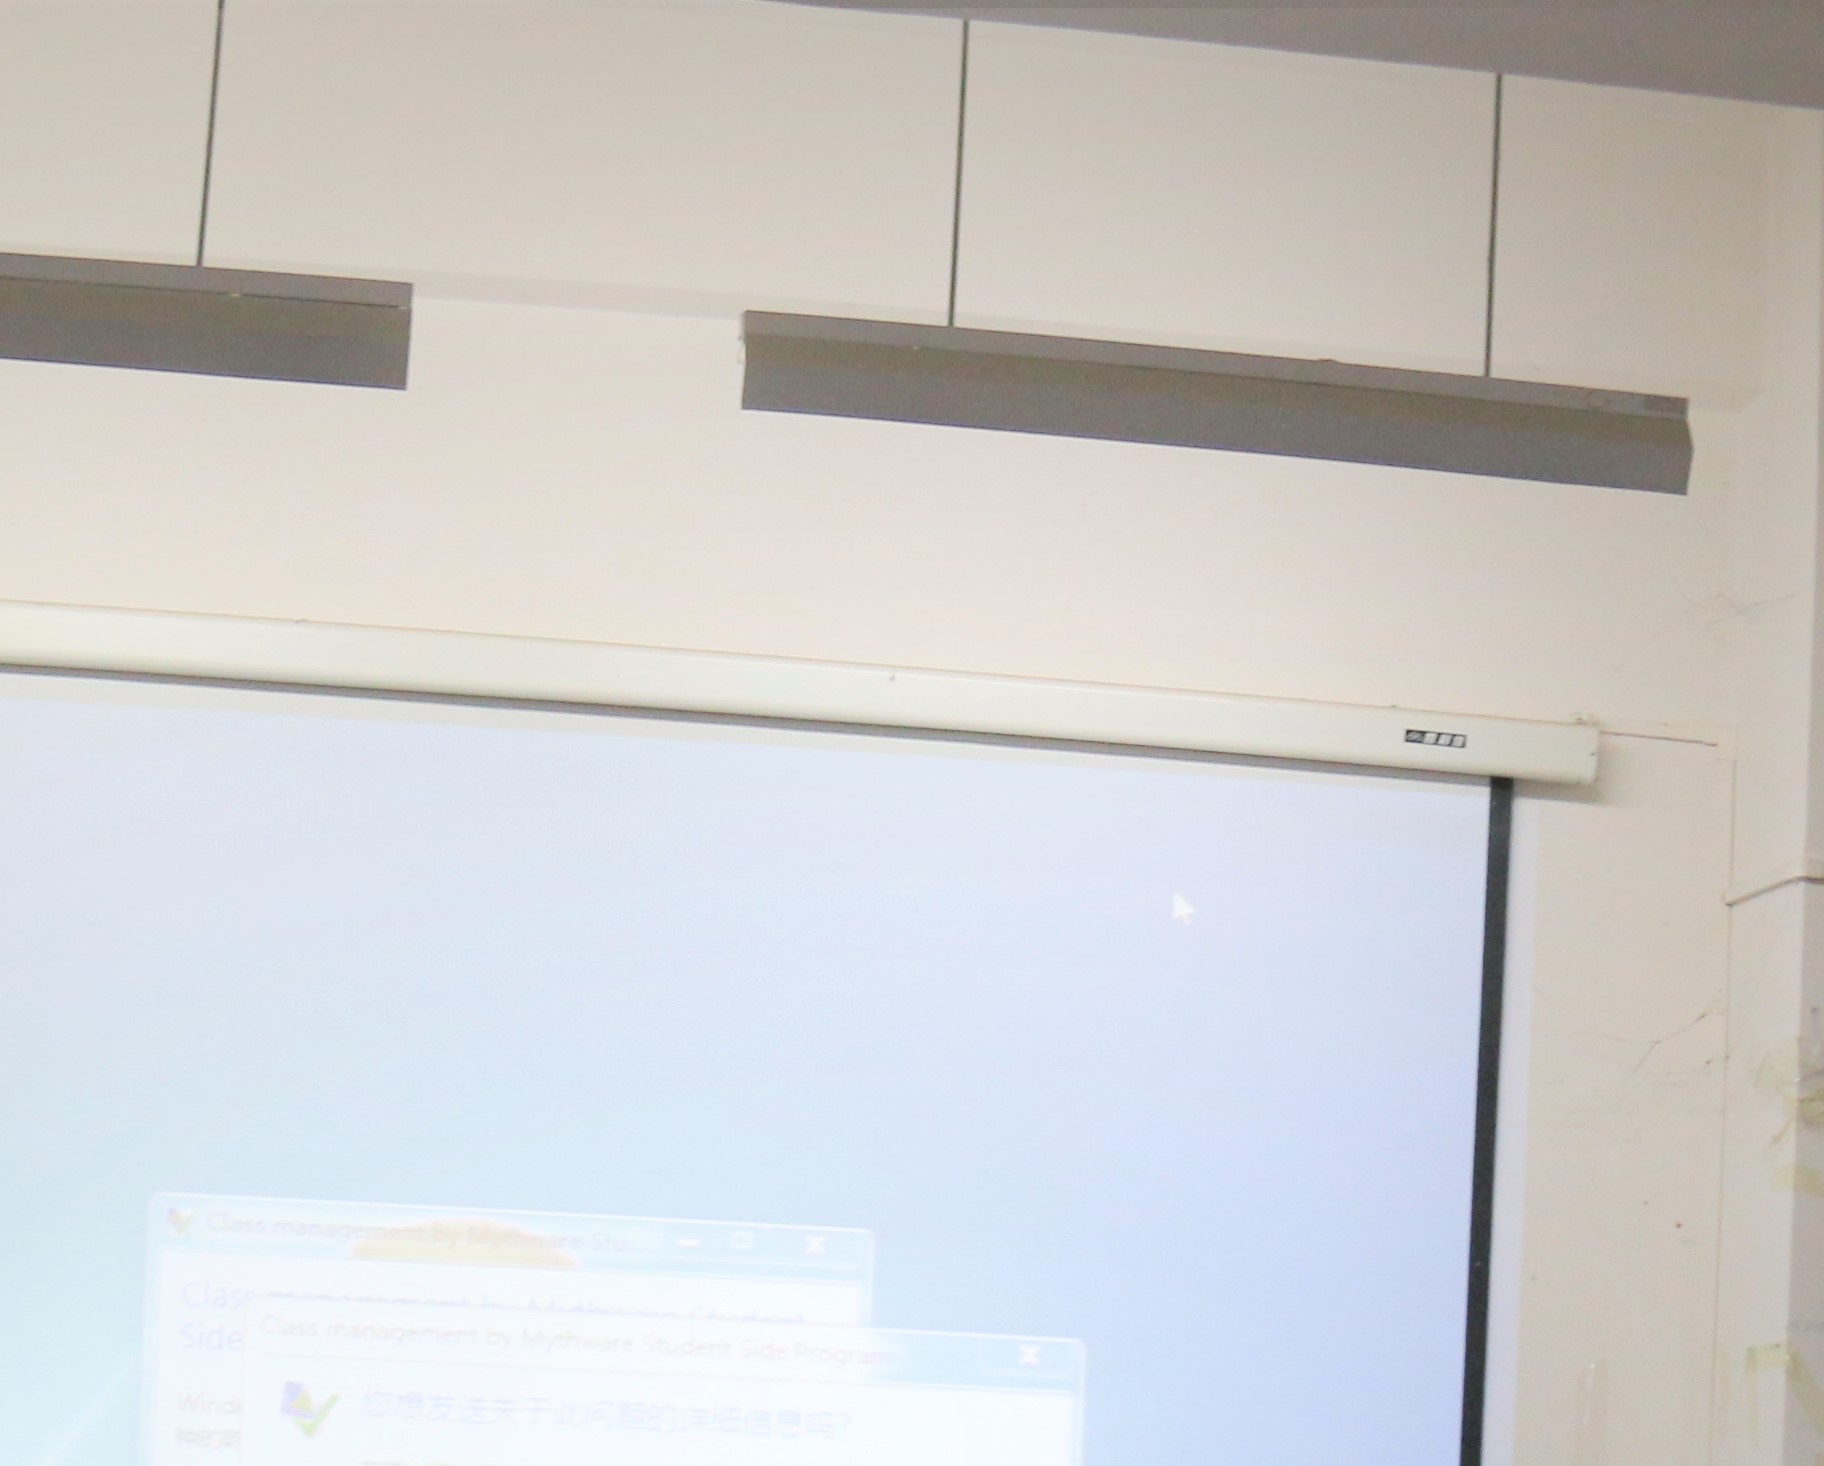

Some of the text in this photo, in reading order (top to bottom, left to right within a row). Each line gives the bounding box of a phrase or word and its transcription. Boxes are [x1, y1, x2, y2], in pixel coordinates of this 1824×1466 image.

[260, 1313, 319, 1339] Class
[327, 1321, 480, 1348] management
[486, 1329, 512, 1353] by
[642, 1332, 733, 1358] Student
[738, 1337, 787, 1361] Side
